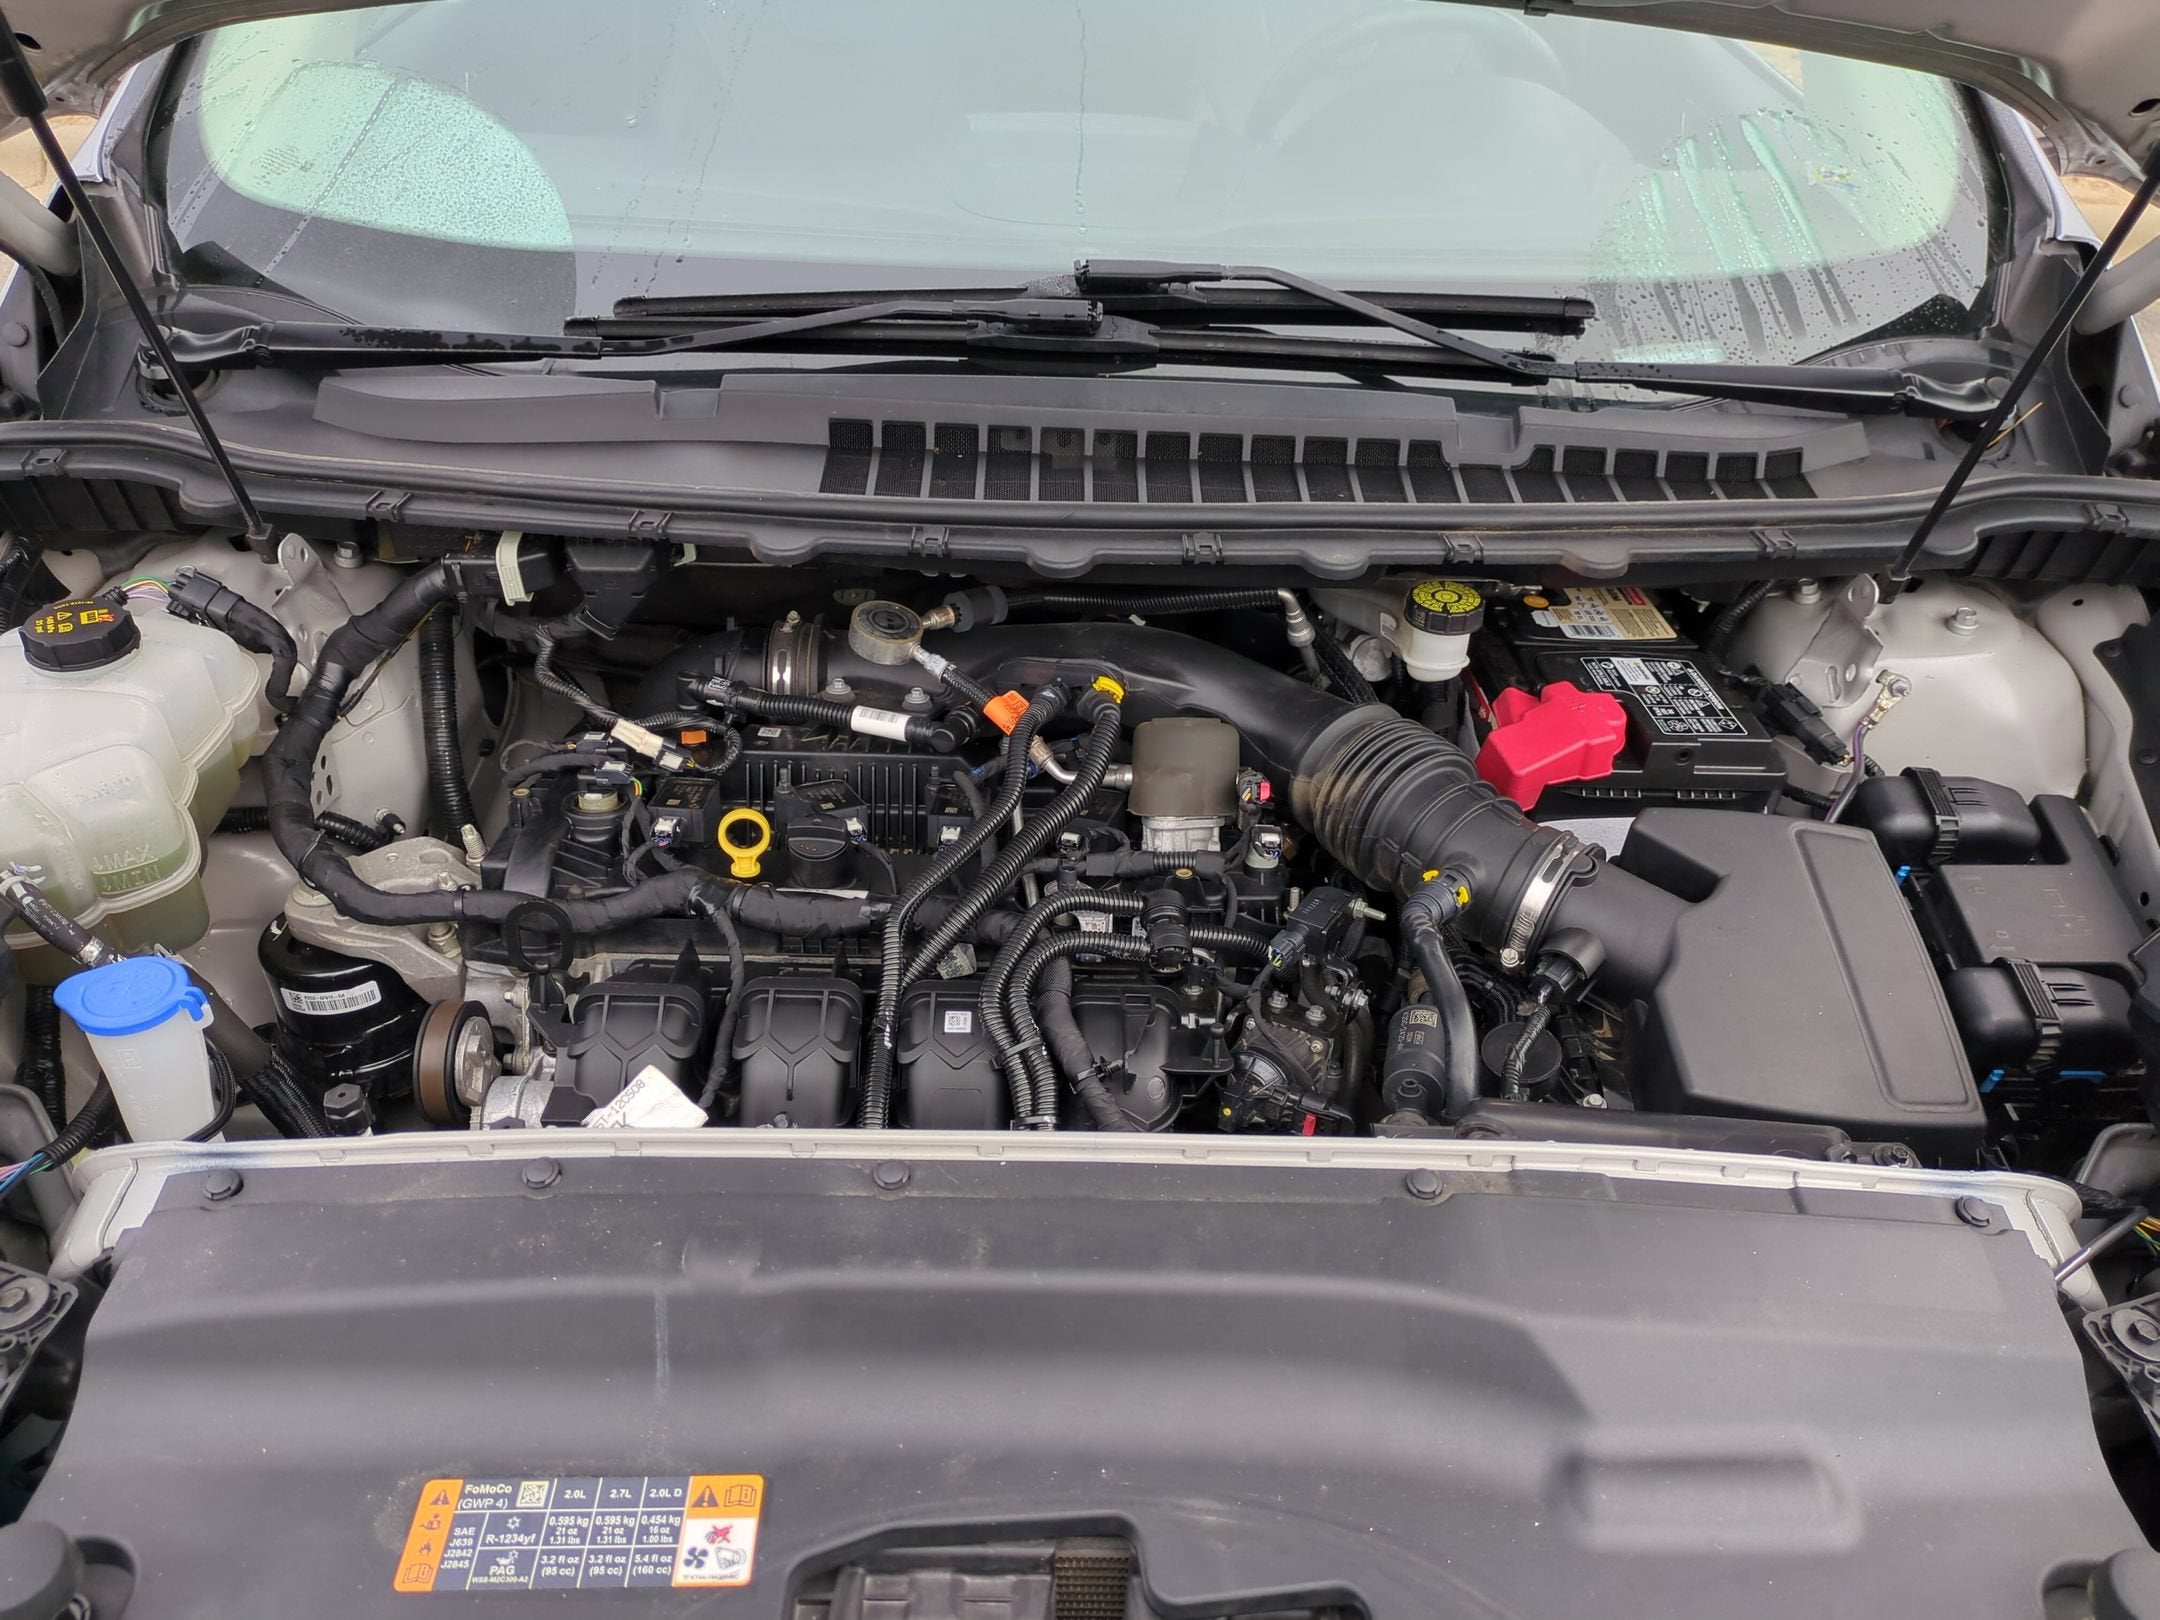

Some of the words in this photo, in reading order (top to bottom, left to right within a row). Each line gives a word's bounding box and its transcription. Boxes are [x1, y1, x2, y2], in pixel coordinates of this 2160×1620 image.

[103, 844, 155, 870] MAX
[112, 864, 160, 889] MIN
[465, 1484, 512, 1494] FoMoCo
[564, 1489, 586, 1499] 2.0L
[609, 1489, 631, 1498] 2.7L
[649, 1488, 671, 1498] 2.0L
[674, 1488, 682, 1497] D
[457, 1498, 493, 1510] (GWP
[495, 1498, 509, 1510] 4)
[549, 1516, 575, 1526] 0.595
[576, 1516, 589, 1528] kg
[595, 1515, 621, 1526] 0.595
[622, 1515, 635, 1527] kg
[641, 1515, 667, 1525] 0.454
[668, 1515, 681, 1526] kg
[453, 1527, 476, 1536] SAE
[555, 1526, 566, 1535] 21
[602, 1526, 613, 1535] 21
[449, 1538, 473, 1547] J639
[485, 1533, 536, 1545] R-1234yf
[549, 1536, 566, 1544] 1.31
[567, 1536, 580, 1544] lbs
[596, 1536, 613, 1544] 1.31
[614, 1536, 627, 1544] lbs
[642, 1535, 659, 1543] 1.00
[660, 1535, 673, 1543] lbs
[444, 1549, 473, 1557] J2842
[540, 1555, 556, 1564] 3.2
[557, 1554, 565, 1564] fl
[567, 1556, 579, 1564] oz
[588, 1555, 603, 1564] 3.2
[604, 1554, 612, 1564] fl
[614, 1555, 626, 1564] oz
[634, 1554, 649, 1564] 5.4
[651, 1554, 658, 1563] fl
[660, 1555, 672, 1563] oz
[440, 1560, 469, 1569] J2845
[489, 1566, 515, 1575] PAG
[541, 1566, 557, 1577] (95
[558, 1566, 575, 1576] cc)
[589, 1566, 605, 1576] (95
[606, 1566, 623, 1576] cc)
[632, 1565, 654, 1576] (160
[655, 1565, 672, 1576] cc)
